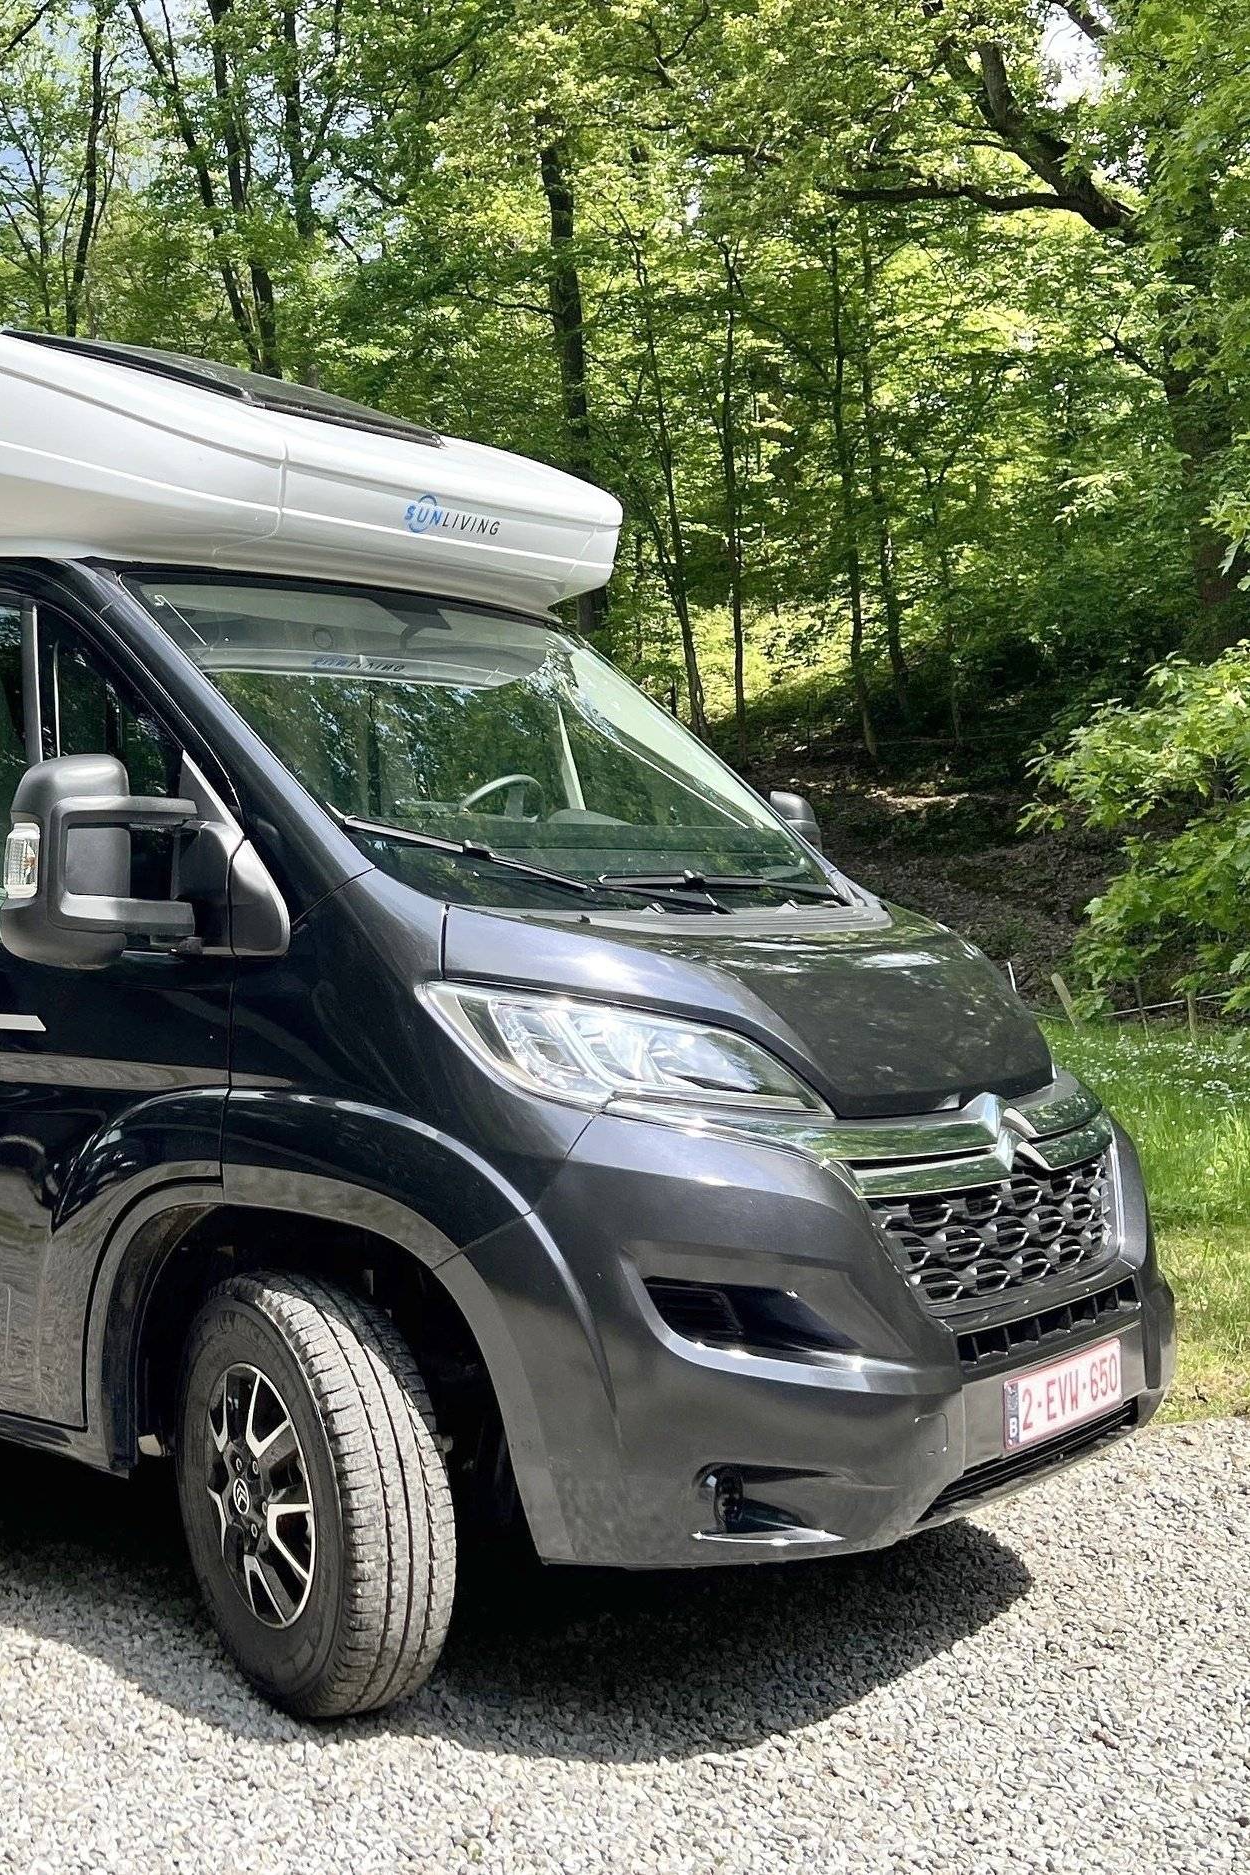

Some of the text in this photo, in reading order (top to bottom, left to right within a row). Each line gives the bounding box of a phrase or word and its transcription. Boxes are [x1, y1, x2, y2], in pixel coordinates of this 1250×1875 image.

[404, 503, 501, 536] SUNLIVING
[1022, 1353, 1118, 1432] 2-EVW-650
[1009, 1416, 1018, 1439] B
